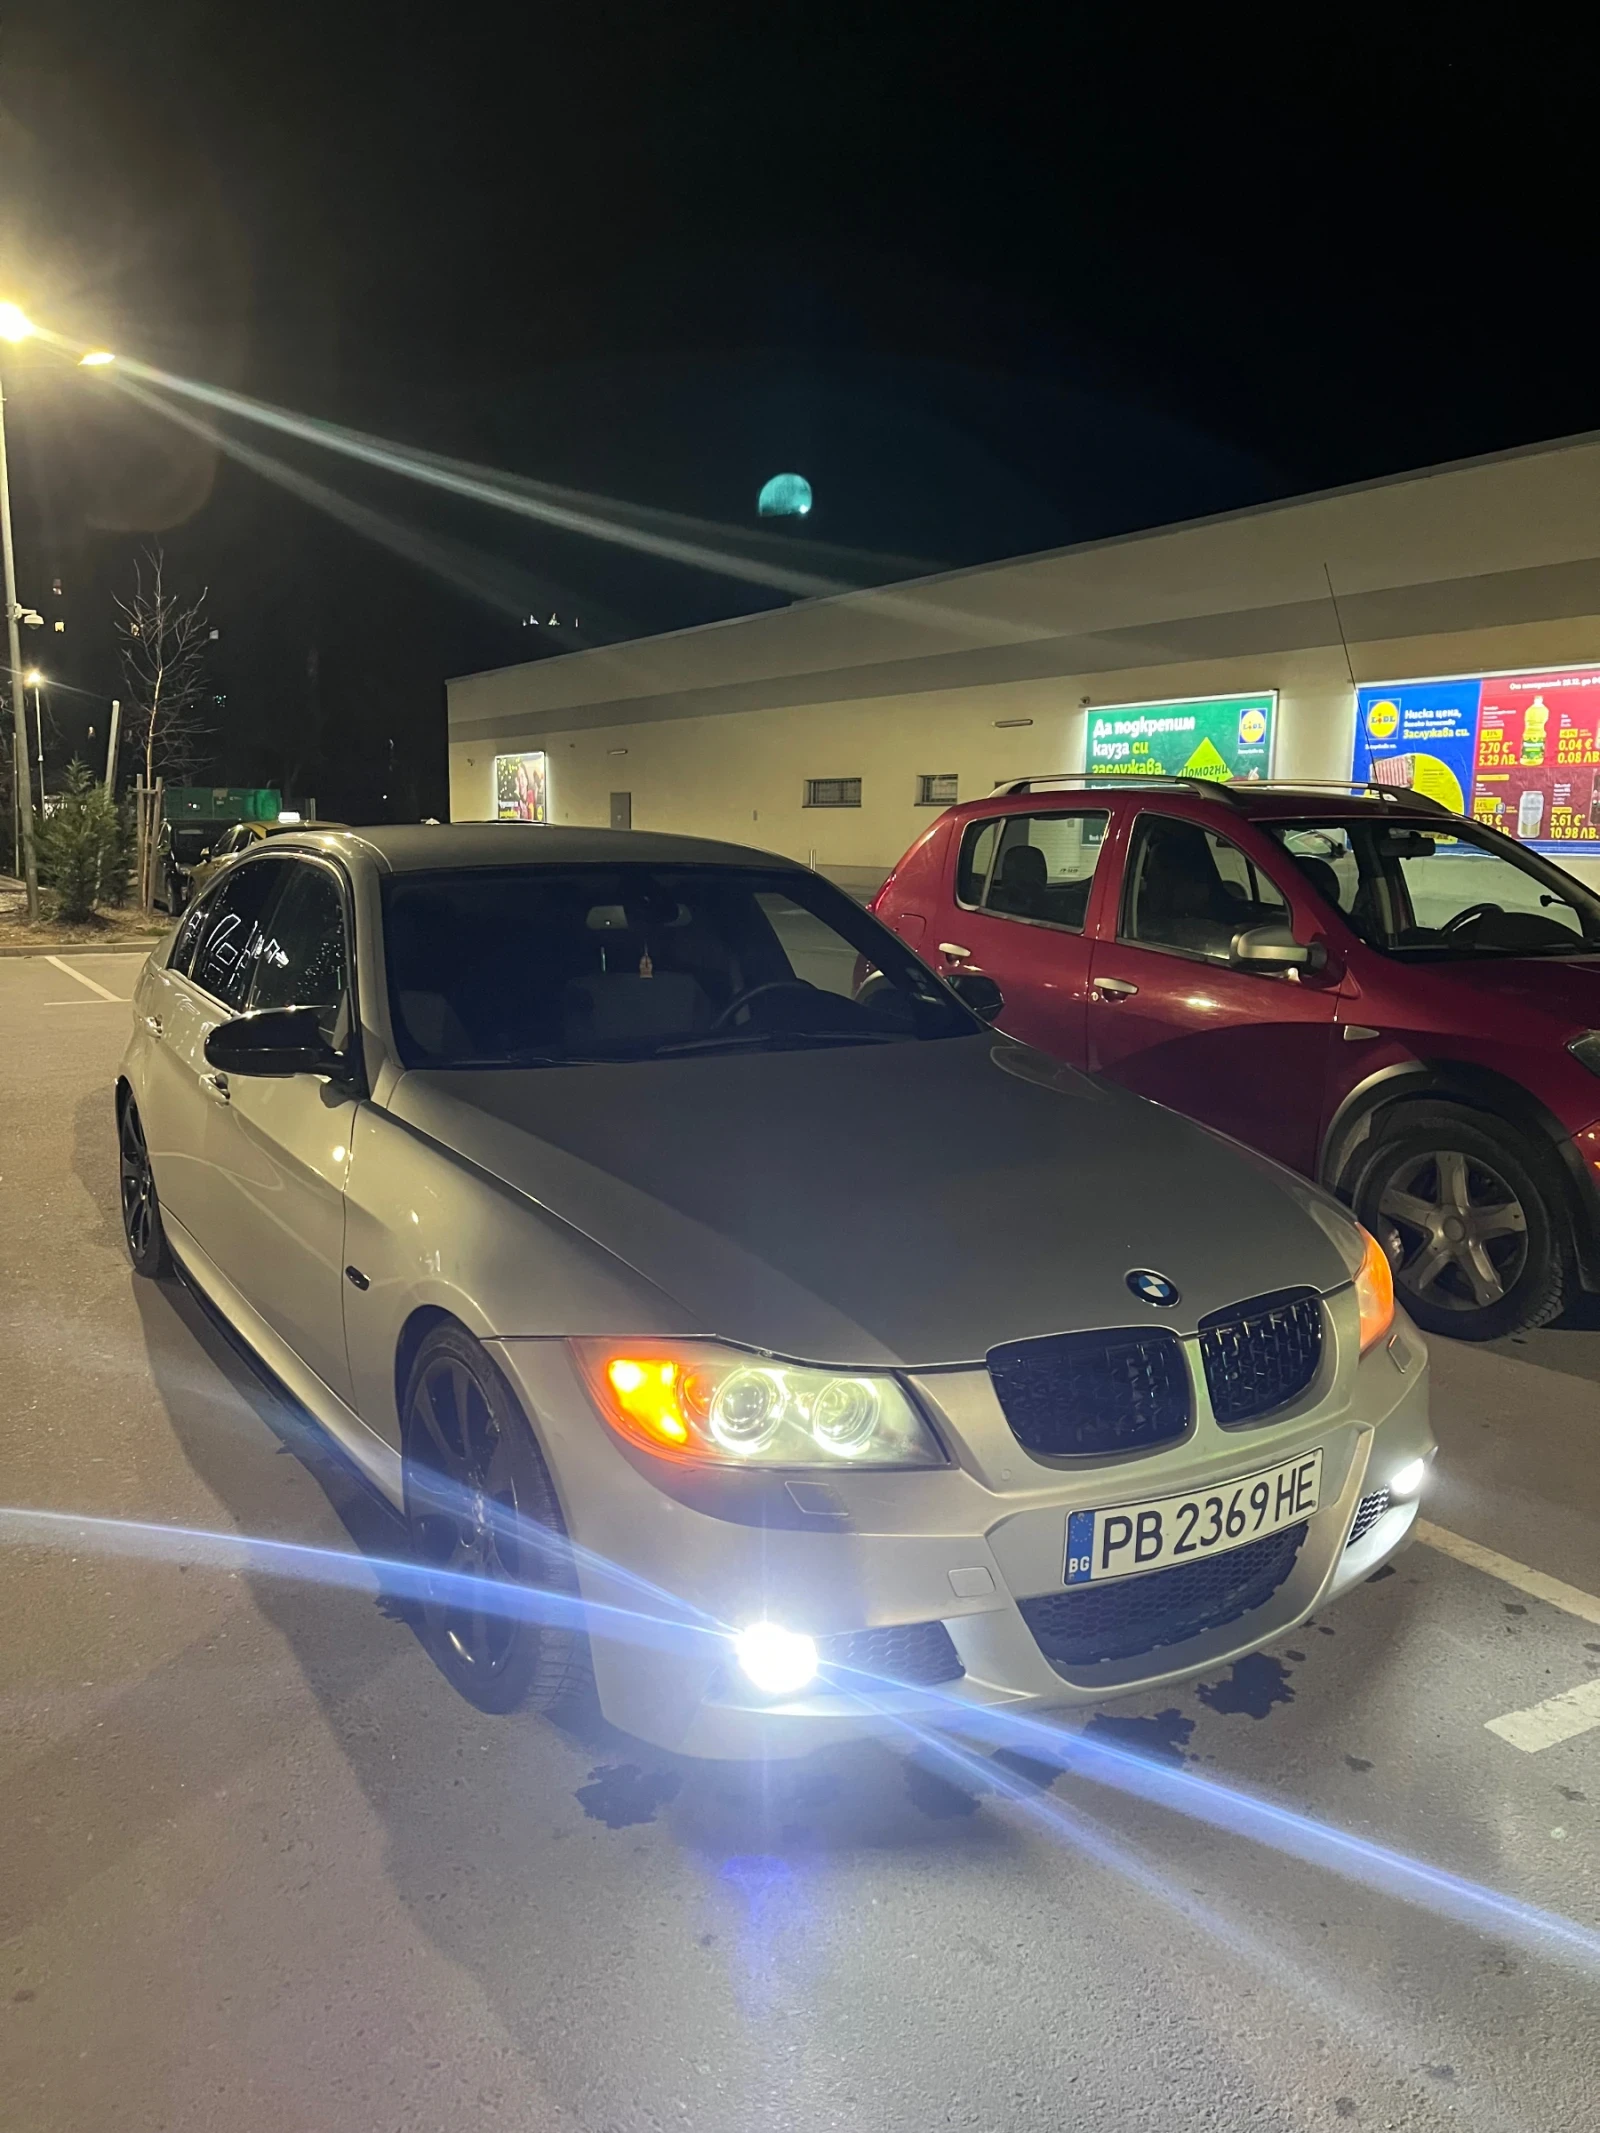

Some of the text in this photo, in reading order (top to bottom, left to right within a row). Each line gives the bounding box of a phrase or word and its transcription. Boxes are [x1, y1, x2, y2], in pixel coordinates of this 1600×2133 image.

[1404, 708, 1462, 719] Ниска цена,
[1093, 715, 1196, 738] Да подкрепим
[1403, 726, 1470, 741] Заслужава си.
[1093, 739, 1149, 760] кауза си
[1479, 741, 1501, 754] 2.70
[1558, 738, 1594, 751] 0.04 €
[1478, 753, 1518, 766] 5.29 ЛВ.
[1557, 751, 1582, 764] 0.08
[1181, 763, 1229, 778] Помогни
[1494, 814, 1504, 825] €
[1550, 814, 1571, 826] 5.61
[1550, 826, 1600, 839] 10.98 ЛВ.
[1101, 1460, 1316, 1570] PB 2369 HE
[1068, 1555, 1090, 1574] BG
